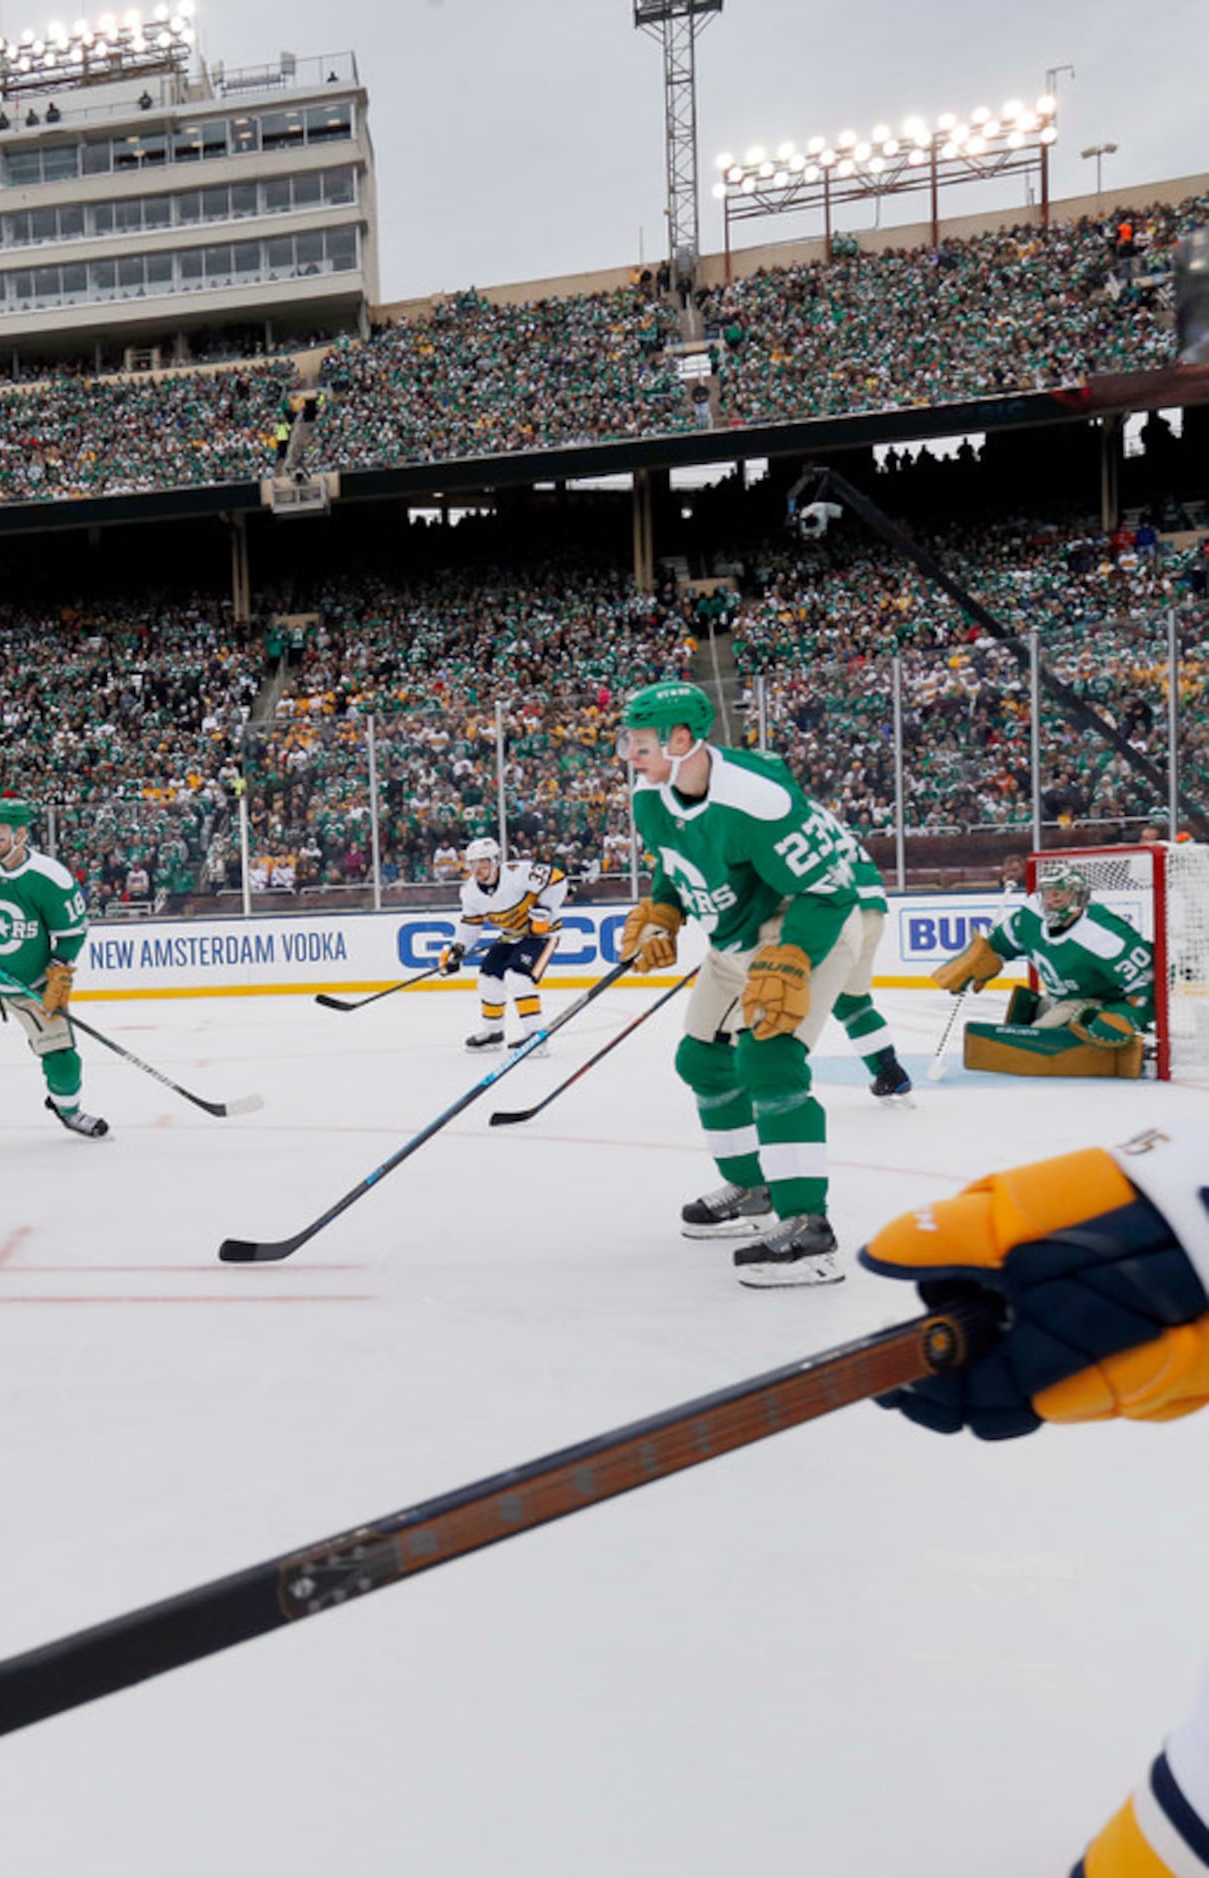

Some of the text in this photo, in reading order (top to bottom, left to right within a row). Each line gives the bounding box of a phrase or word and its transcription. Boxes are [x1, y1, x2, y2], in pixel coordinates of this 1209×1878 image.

[774, 811, 834, 877] 23
[64, 891, 86, 924] 18
[89, 931, 347, 970] NEW AMSTERDAM VODKA
[1114, 946, 1151, 981] 30
